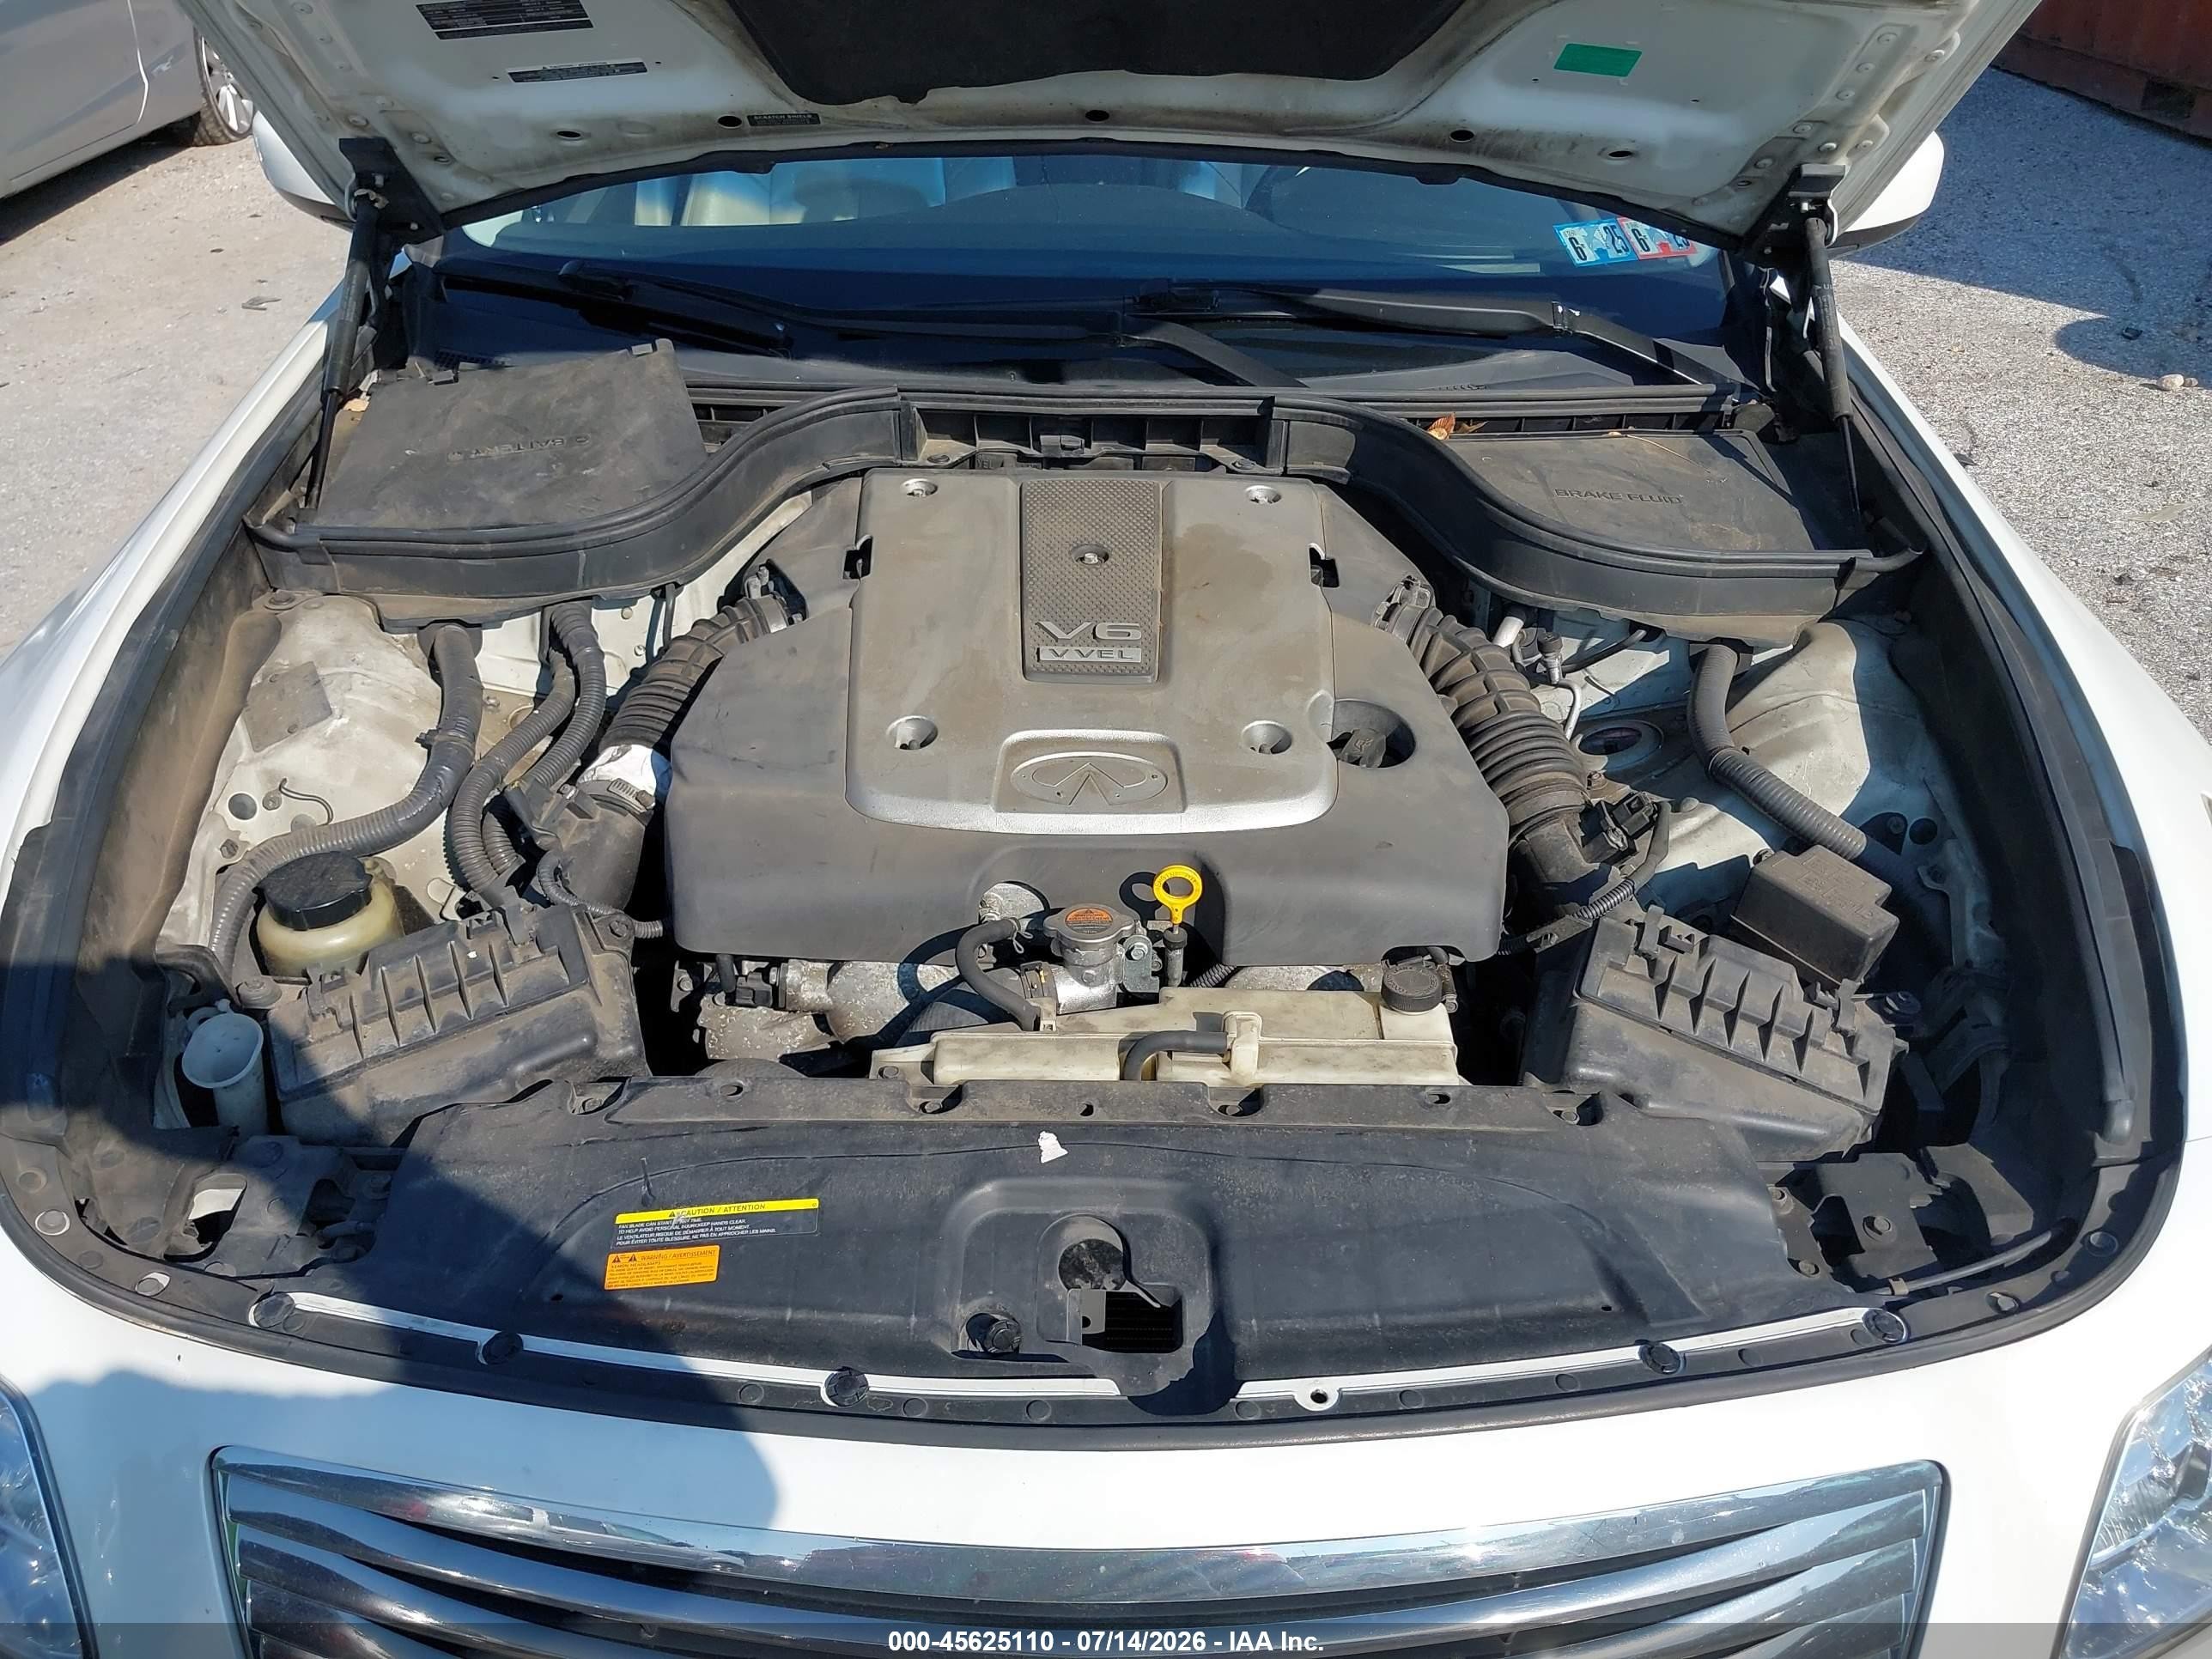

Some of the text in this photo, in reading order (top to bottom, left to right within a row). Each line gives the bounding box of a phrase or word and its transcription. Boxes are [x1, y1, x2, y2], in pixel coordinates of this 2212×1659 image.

[1568, 224, 1630, 261] 6 25
[1631, 228, 1650, 252] 6
[1553, 489, 1683, 505] BRAKE FLUID
[1036, 621, 1142, 641] V6
[1048, 648, 1133, 659] VVEL
[680, 1207, 714, 1217] CAUTION
[723, 1203, 766, 1212] ATTENTION
